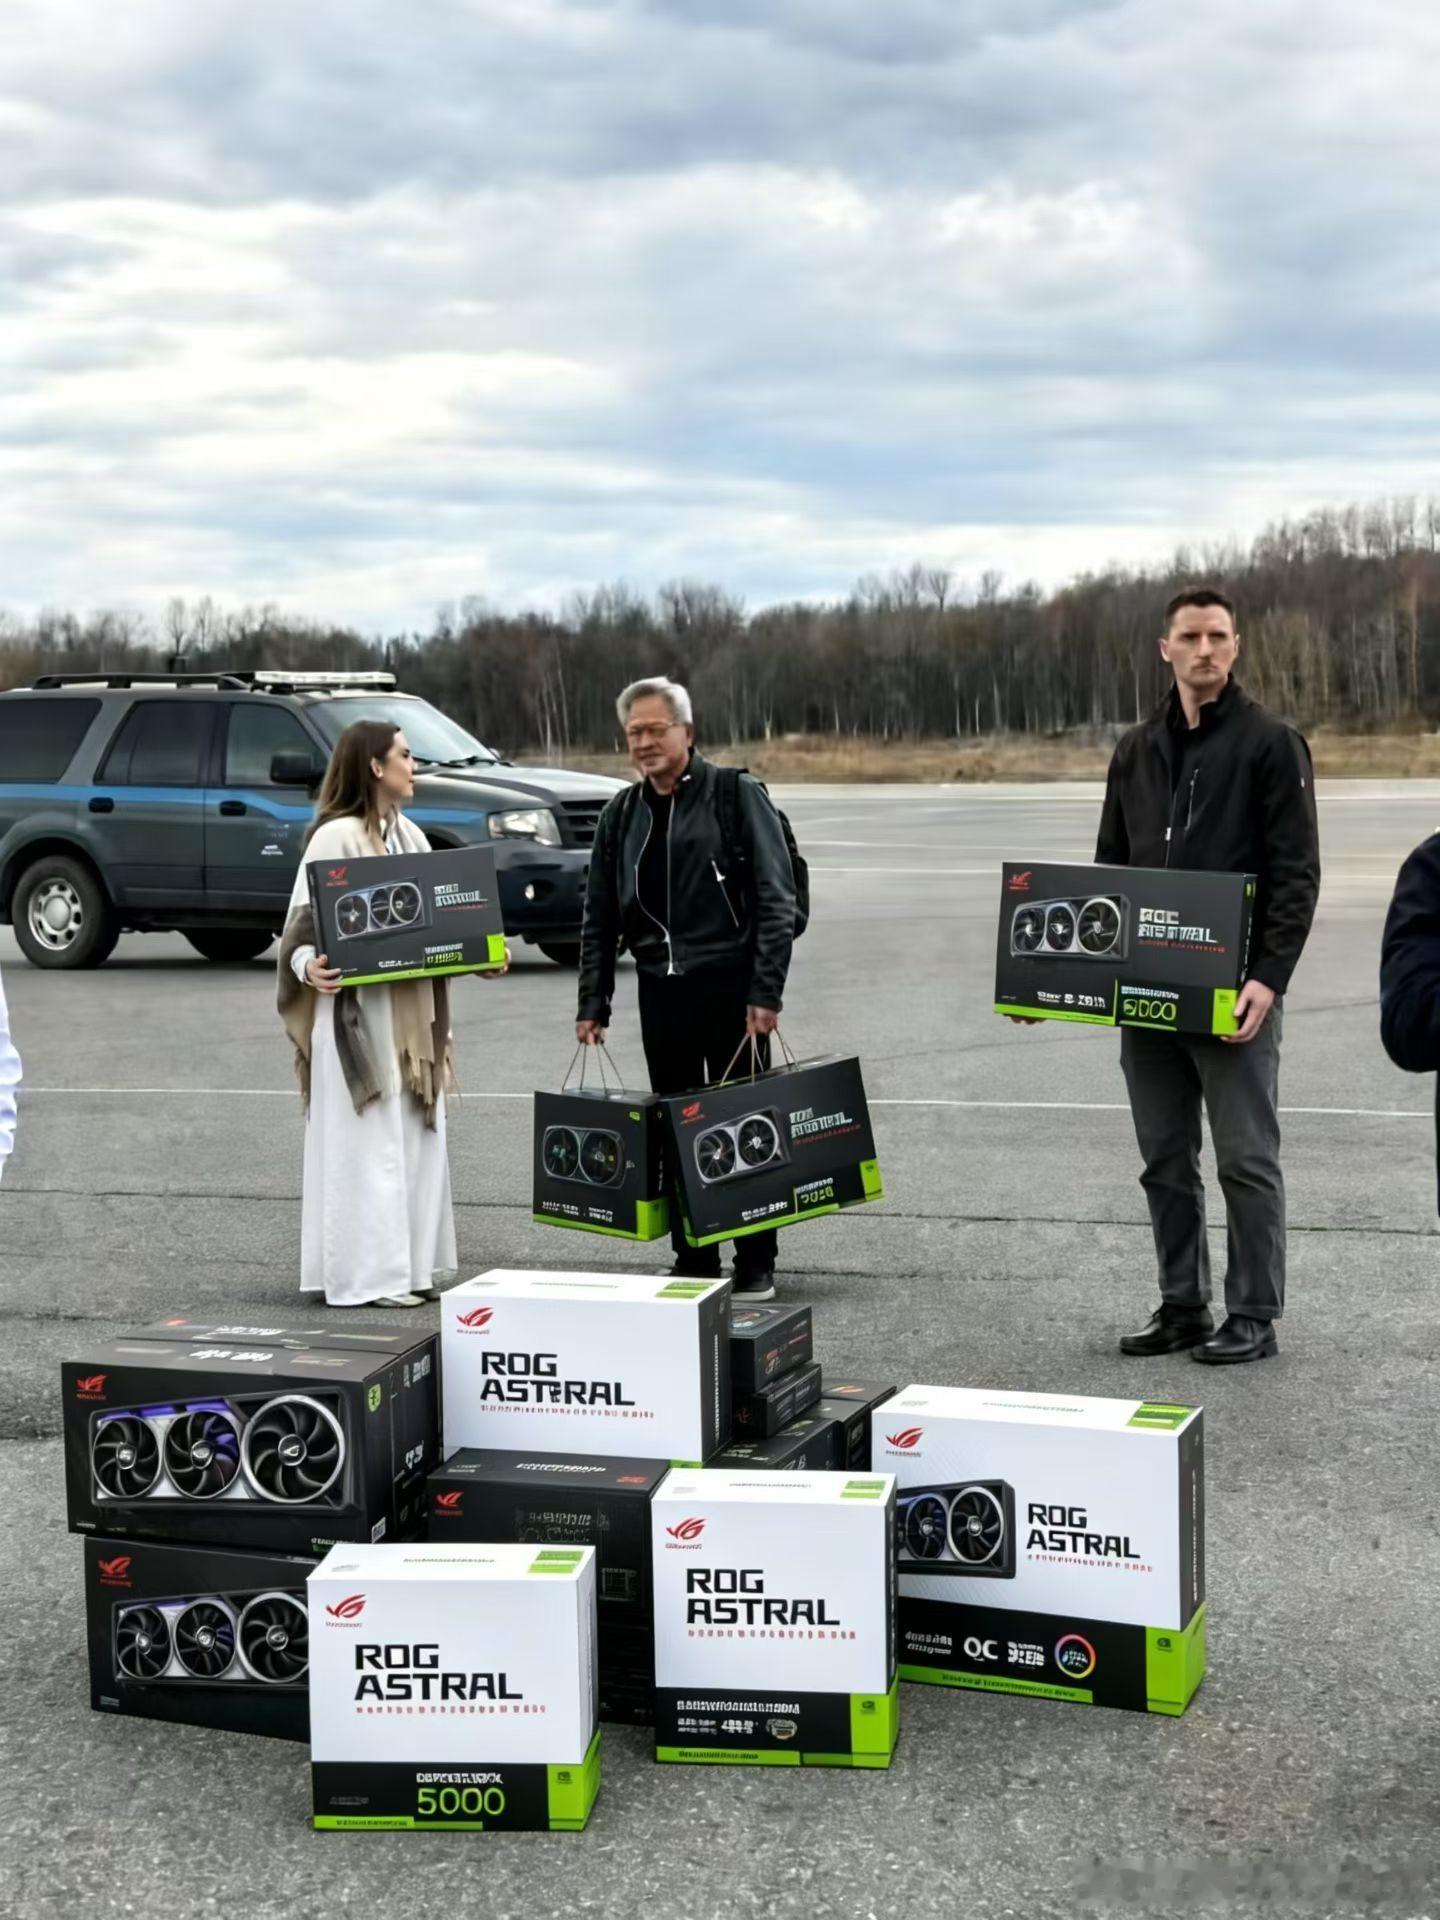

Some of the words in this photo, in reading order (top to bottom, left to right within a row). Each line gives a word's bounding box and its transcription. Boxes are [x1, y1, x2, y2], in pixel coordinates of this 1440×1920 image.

[481, 1352, 557, 1376] ROG
[1028, 1503, 1087, 1528] ROG
[1027, 1529, 1141, 1558] ASTRAL
[687, 1568, 764, 1593] ROG
[687, 1598, 840, 1625] ASTRAL
[355, 1644, 439, 1670] ROG
[354, 1673, 523, 1701] ASTRAL
[417, 1787, 506, 1815] 5000
